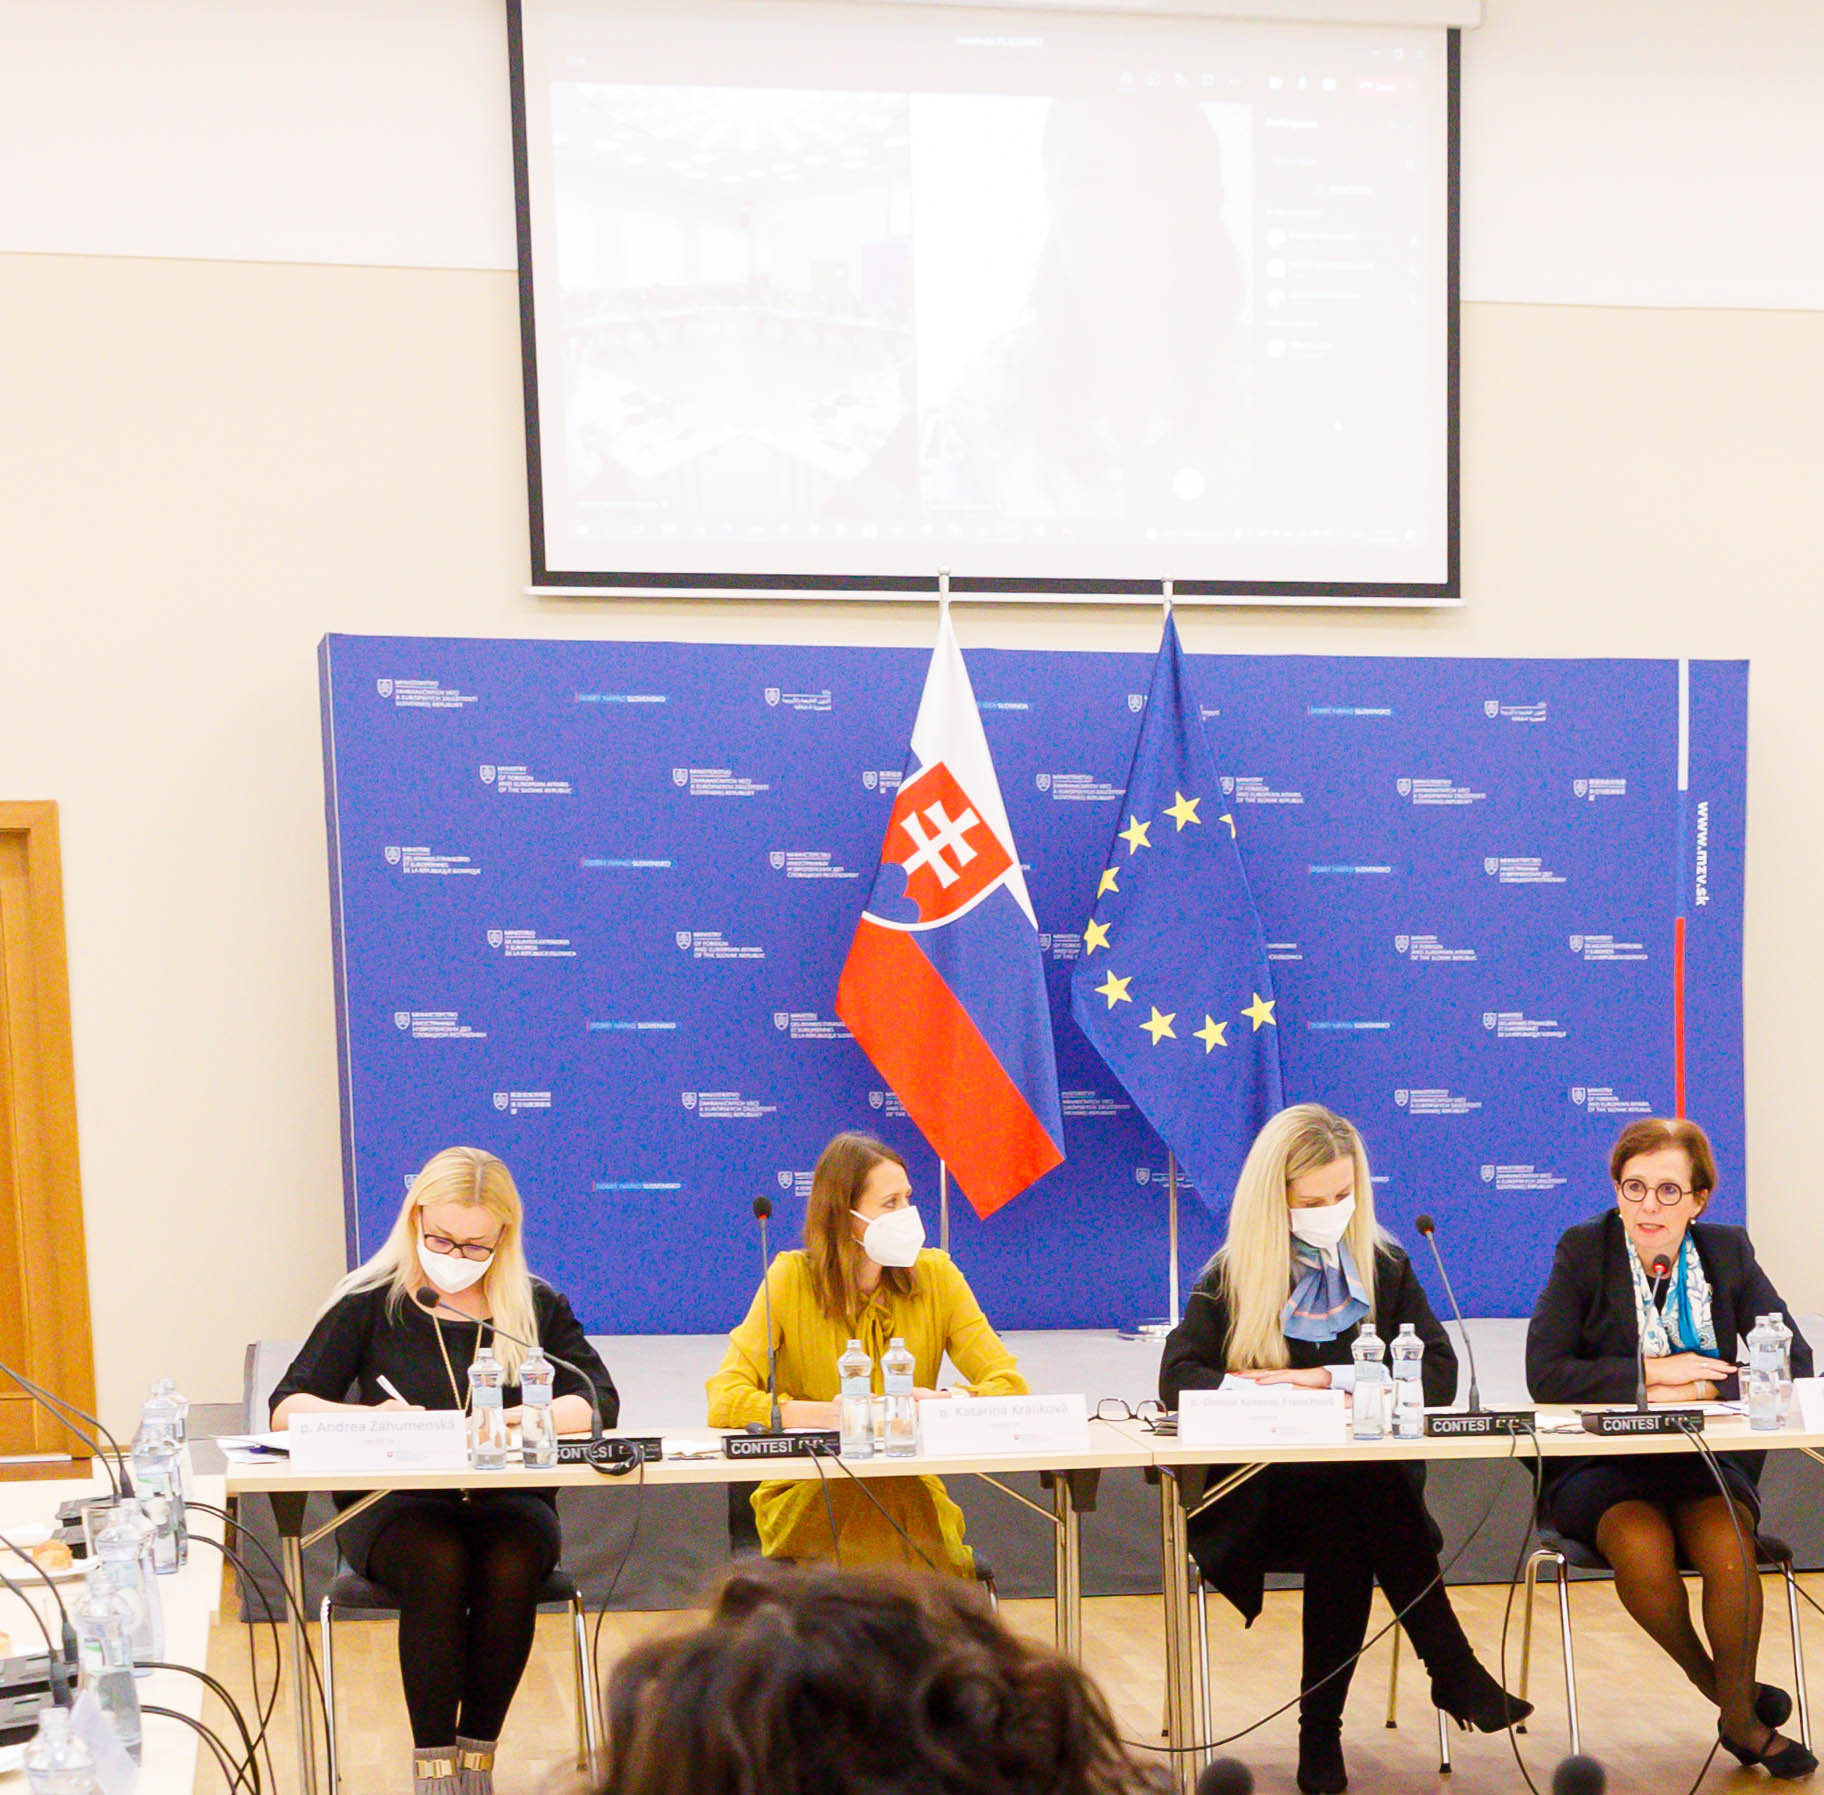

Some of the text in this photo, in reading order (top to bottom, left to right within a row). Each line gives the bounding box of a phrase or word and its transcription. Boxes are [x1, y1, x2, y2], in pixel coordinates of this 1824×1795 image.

[1696, 801, 1710, 906] www.mzv.sk
[317, 1421, 366, 1433] Andrea
[1432, 1416, 1493, 1432] CONTEST
[1602, 1415, 1662, 1432] CONTEST
[557, 1444, 613, 1460] ONTEST
[731, 1438, 796, 1454] CONTEST
